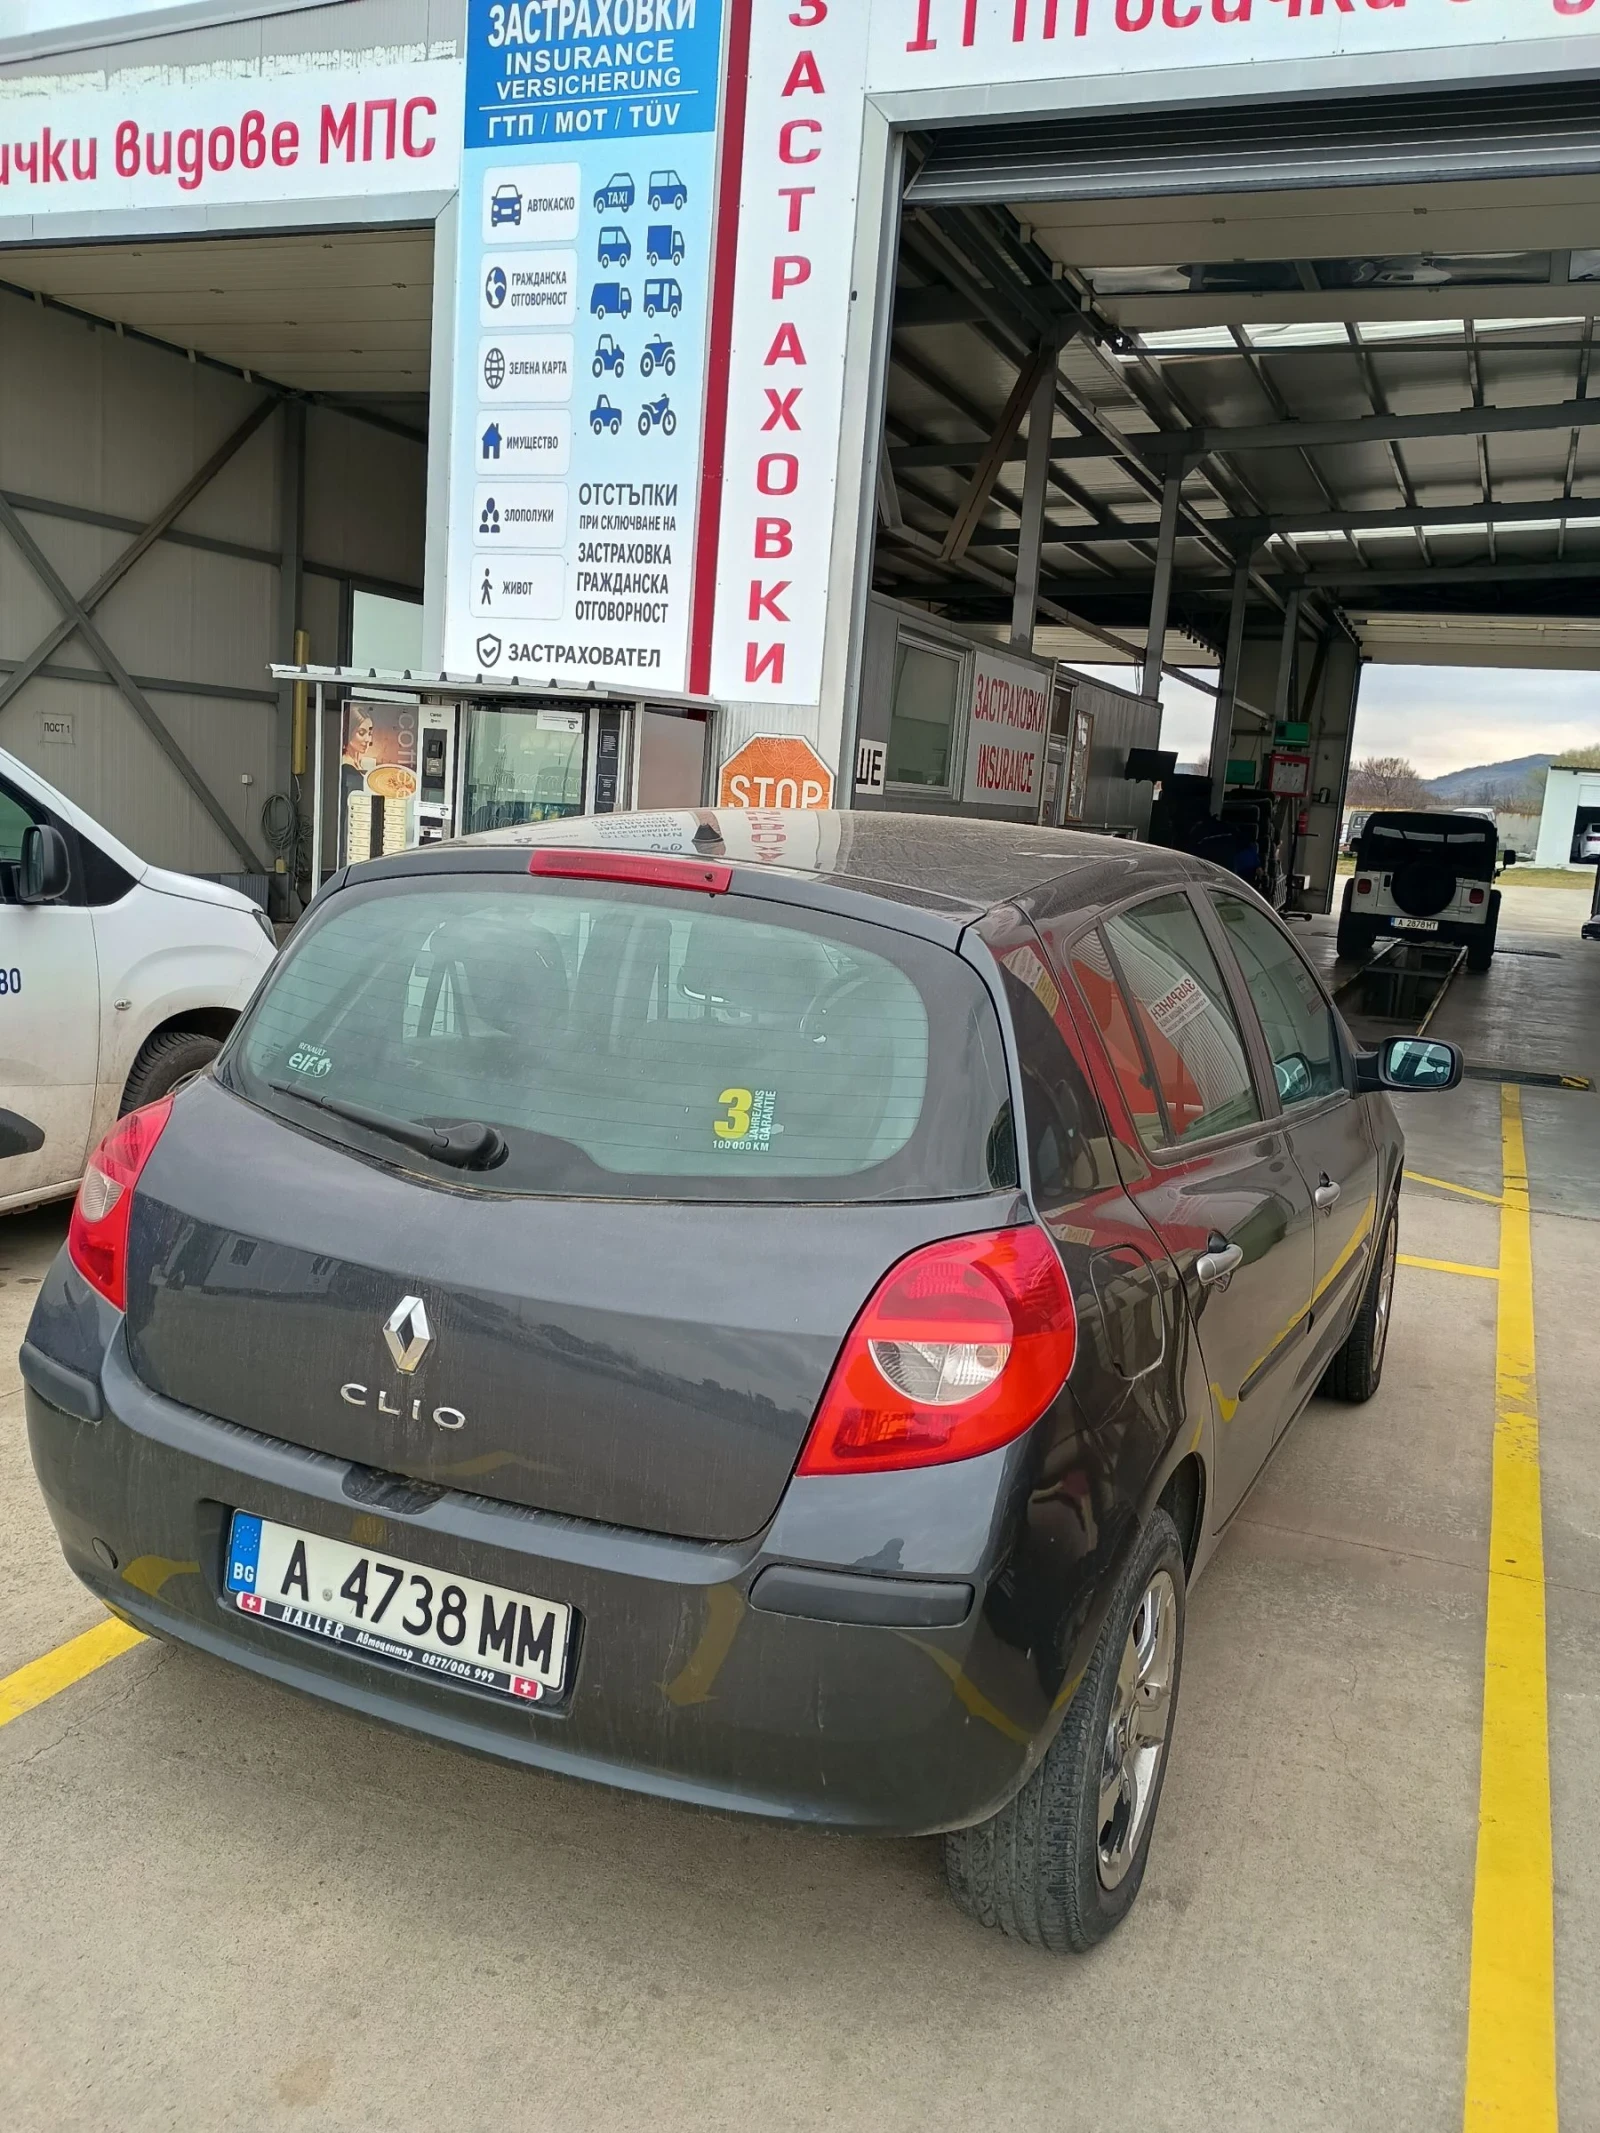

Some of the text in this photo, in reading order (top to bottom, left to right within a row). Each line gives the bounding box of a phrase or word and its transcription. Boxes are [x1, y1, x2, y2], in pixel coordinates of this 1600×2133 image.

[487, 0, 697, 48] ЗАСТРАХОВКИ
[505, 38, 675, 76] INSURANCE
[496, 67, 682, 101] VERSICHERUNG
[488, 114, 534, 139] ГТП
[629, 99, 681, 129] TÜV
[115, 109, 299, 190] видове
[319, 95, 437, 165] МПС
[527, 196, 576, 213] АВТОКАСКО
[607, 191, 628, 205] TAXI
[511, 270, 567, 287] ГРАЖДАНСКА
[510, 291, 568, 307] ОТГОВОРНОСТ
[509, 360, 567, 375] ЗЕЛЕНА КАРТА
[506, 435, 559, 452] ИМУЩЕСТВО
[578, 483, 678, 506] ОТСТЪПКИ
[504, 508, 554, 523] ЗЛОПОЛУКИ
[579, 514, 676, 531] ПРИ СКЛЮЧВАНЕ НА
[578, 542, 672, 565] ЗАСТРАХОВКА
[502, 580, 533, 596] ЖИВОТ
[576, 571, 669, 595] ГРАЖДАНСКА
[575, 600, 669, 623] ОТГОВОРНОСТ
[507, 643, 661, 668] ЗАСТРАХОВАТЕЛ
[974, 673, 1046, 733] ЗАСТРАХОВКИ
[44, 722, 64, 733] ПОСТ
[396, 713, 417, 799] coffee
[976, 743, 1035, 794] INSURANCE
[729, 775, 823, 809] STOP
[298, 1042, 327, 1056] RENAULT
[288, 1052, 319, 1071] elf
[713, 1088, 752, 1139] 3
[749, 1090, 765, 1140] JAHRE/ANS
[759, 1090, 776, 1141] GARANTIE
[753, 1142, 769, 1151] KM
[340, 1383, 466, 1429] CLIO
[233, 1562, 254, 1583] BG
[280, 1539, 556, 1675] A 4738 MM
[281, 1605, 344, 1640] HALLER
[422, 1652, 495, 1683] 0877/006 999
